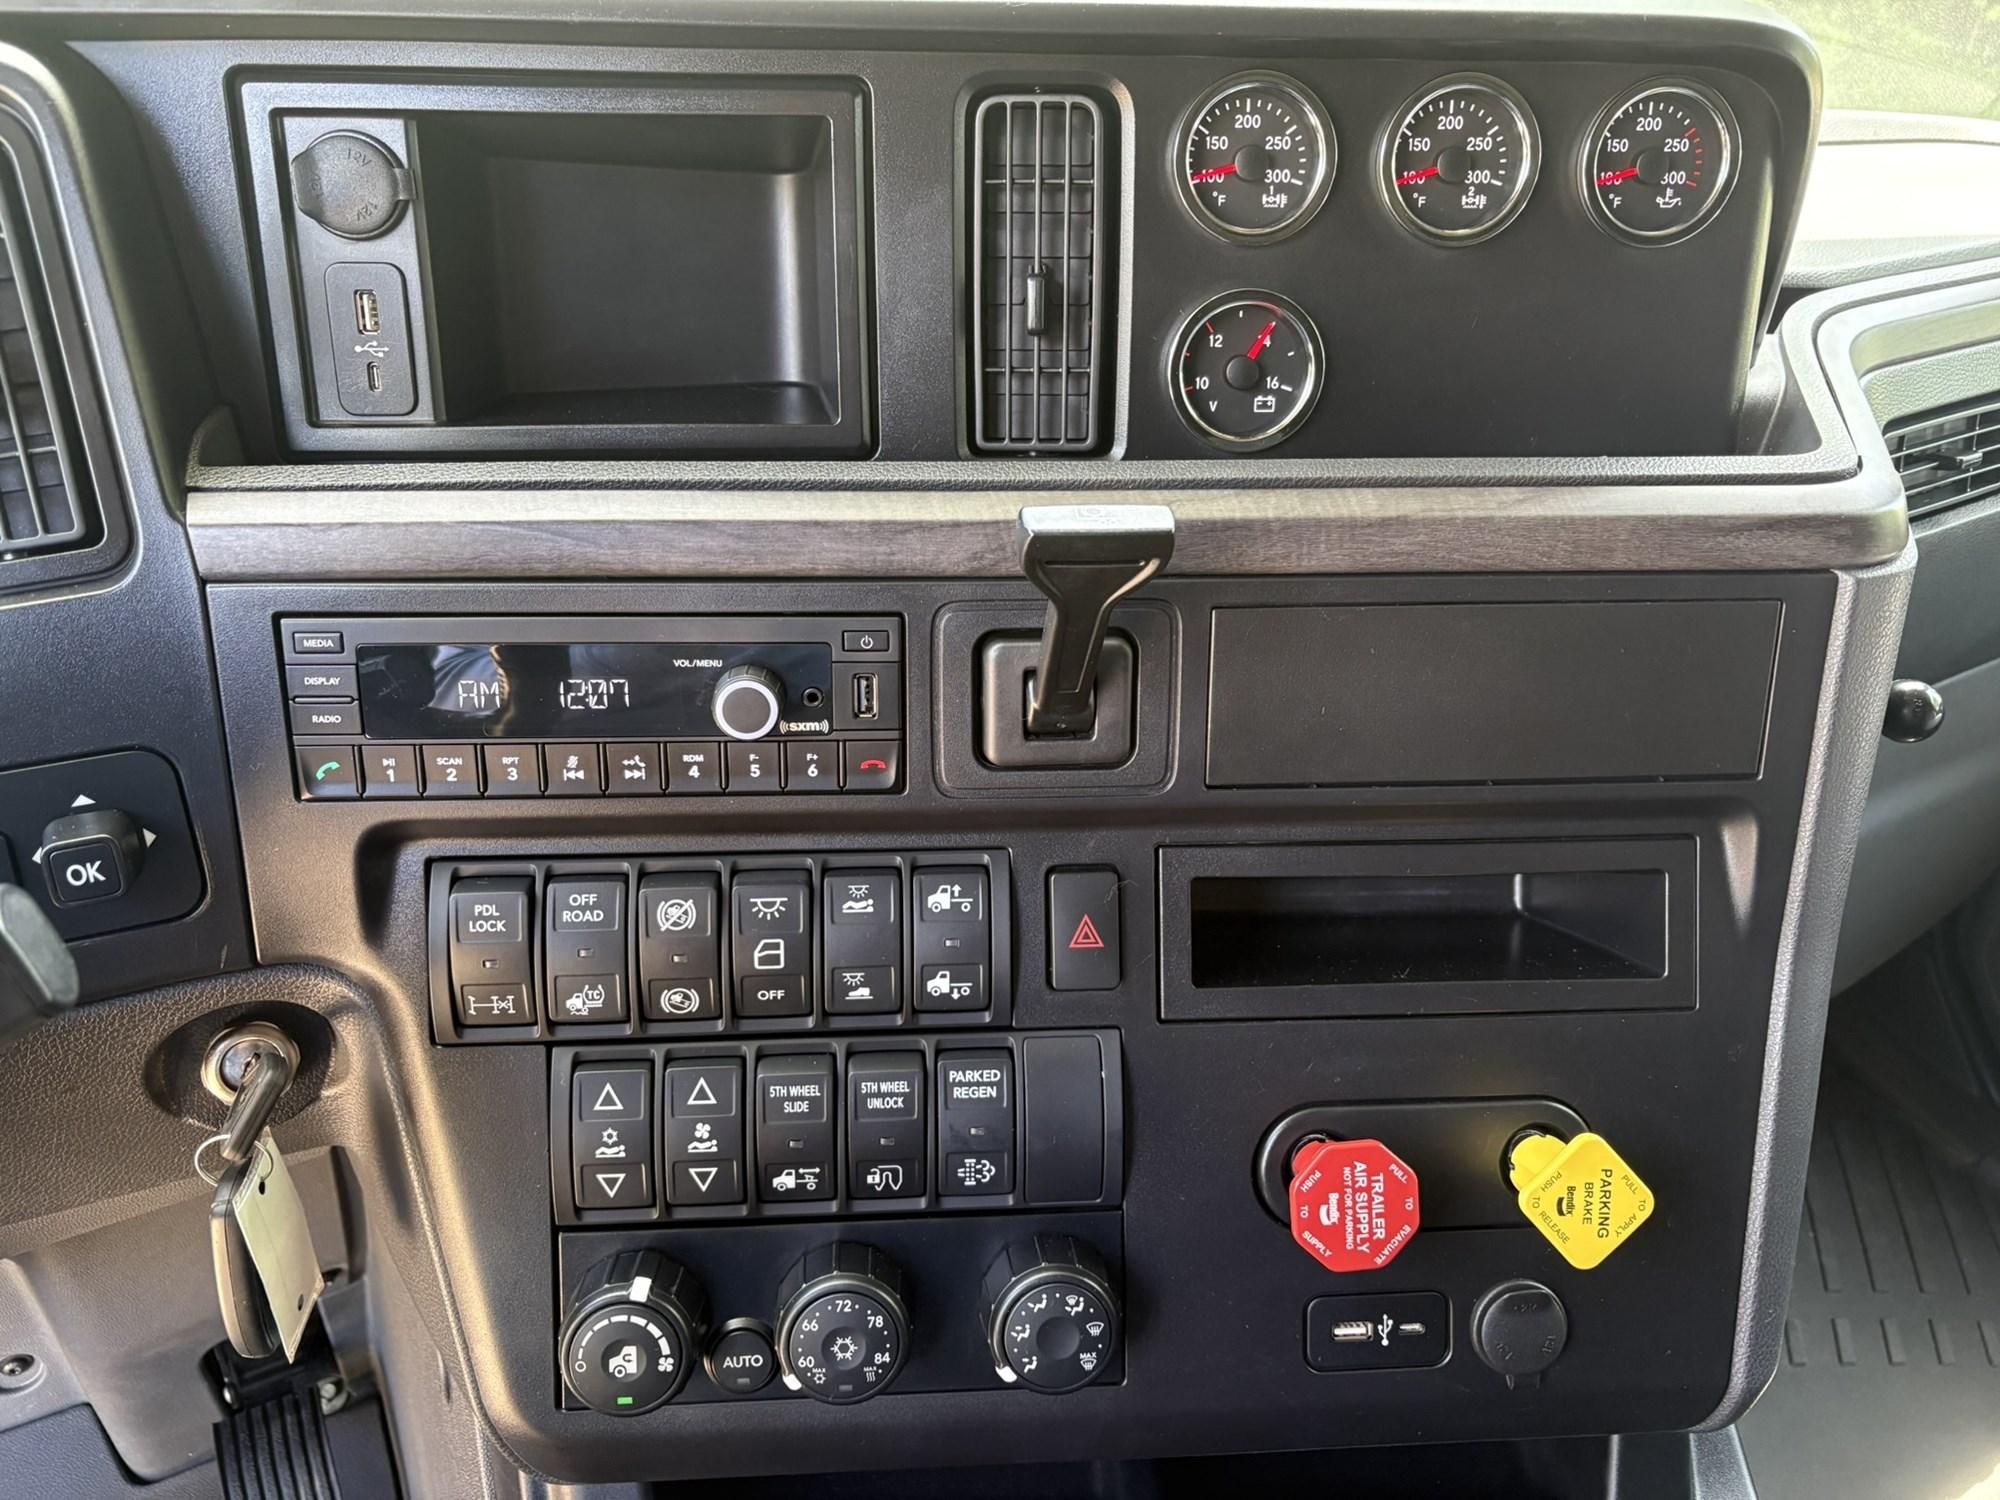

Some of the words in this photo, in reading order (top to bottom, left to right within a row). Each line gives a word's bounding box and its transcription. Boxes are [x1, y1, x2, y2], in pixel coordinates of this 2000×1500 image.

[1235, 115, 1261, 129] 200
[1437, 116, 1463, 130] 200
[1636, 118, 1662, 131] 200
[1206, 136, 1228, 150] 150
[1265, 136, 1291, 150] 250
[1409, 138, 1430, 151] 150
[1467, 137, 1492, 151] 250
[1607, 139, 1628, 152] 150
[1664, 139, 1689, 152] 250
[1265, 169, 1290, 183] 300
[1465, 170, 1490, 184] 300
[1660, 171, 1686, 185] 300
[1209, 334, 1223, 347] 12
[1195, 376, 1209, 389] 10
[1266, 376, 1280, 389] 16
[1209, 401, 1218, 412] V
[303, 639, 334, 647] MEDIA
[673, 659, 722, 667] VOL/MENU
[304, 677, 340, 685] DISPLAY
[458, 679, 501, 708] AM
[560, 679, 629, 709] 12:07
[312, 715, 341, 723] RADIO
[436, 757, 462, 765] SCAN
[386, 769, 395, 782] 1
[446, 768, 457, 781] 2
[507, 768, 518, 781] 3
[688, 765, 700, 778] 4
[750, 764, 760, 777] 5
[807, 764, 818, 777] 6
[66, 860, 106, 887] OK
[569, 894, 598, 906] OFF
[474, 904, 500, 916] PDL
[562, 910, 604, 923] ROAD
[469, 920, 506, 933] LOCK
[757, 990, 785, 1000] OFF
[949, 1070, 1001, 1083] PARKED
[769, 1086, 788, 1098] 5TH
[789, 1085, 821, 1097] WHEEL
[861, 1082, 878, 1094] 5TH
[880, 1081, 910, 1093] WHEEL
[953, 1086, 997, 1098] REGEN
[784, 1101, 809, 1113] SLIDE
[867, 1097, 904, 1109] UNLOCK
[1343, 1166, 1352, 1186] NOT
[1354, 1161, 1368, 1188] AIR
[1388, 1164, 1408, 1184] PULL
[1300, 1170, 1322, 1192] PUSH
[1540, 1171, 1562, 1192] PUSH
[1621, 1174, 1638, 1195] PULL
[1344, 1188, 1353, 1208] FOR
[1405, 1197, 1414, 1210] TO
[1532, 1196, 1541, 1209] TO
[1566, 1186, 1576, 1216] Bendix
[1582, 1182, 1594, 1225] BRAKE
[1597, 1169, 1613, 1239] PARKING
[1300, 1205, 1309, 1218] TO
[1371, 1173, 1386, 1240] TRAILER
[1638, 1199, 1646, 1212] TO
[1355, 1192, 1370, 1253] SUPPLY
[1539, 1211, 1570, 1244] RELEASE
[1615, 1214, 1637, 1238] APPLY
[1344, 1209, 1354, 1250] PARKING
[1302, 1231, 1332, 1257] SUPPLY
[1374, 1225, 1411, 1264] EVACUATE
[835, 1300, 852, 1312] 72
[802, 1319, 819, 1331] 66
[867, 1316, 884, 1328] 78
[723, 1355, 763, 1368] AUTO
[798, 1356, 814, 1367] 60
[874, 1352, 890, 1364] 84
